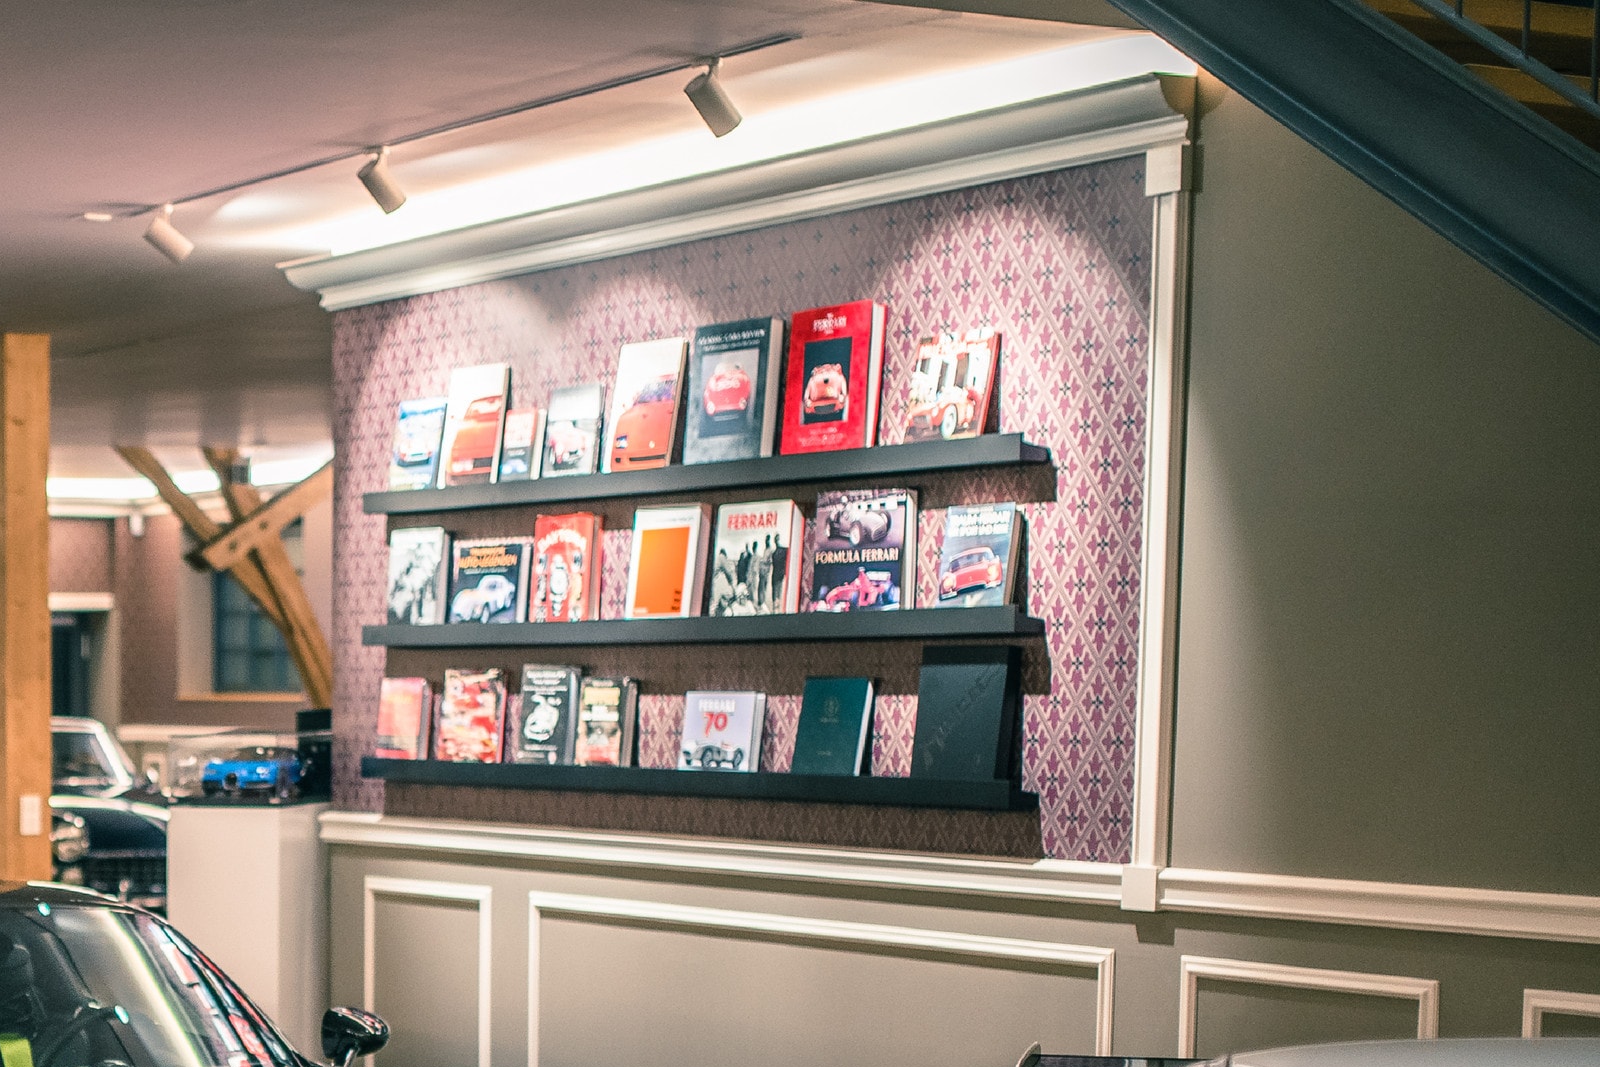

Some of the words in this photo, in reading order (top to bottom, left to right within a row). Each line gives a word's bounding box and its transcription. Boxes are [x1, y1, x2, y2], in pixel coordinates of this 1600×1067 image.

[727, 510, 778, 530] FERRARI
[815, 549, 860, 565] FORMULA
[861, 546, 900, 562] FERRARI
[703, 712, 728, 737] 70
